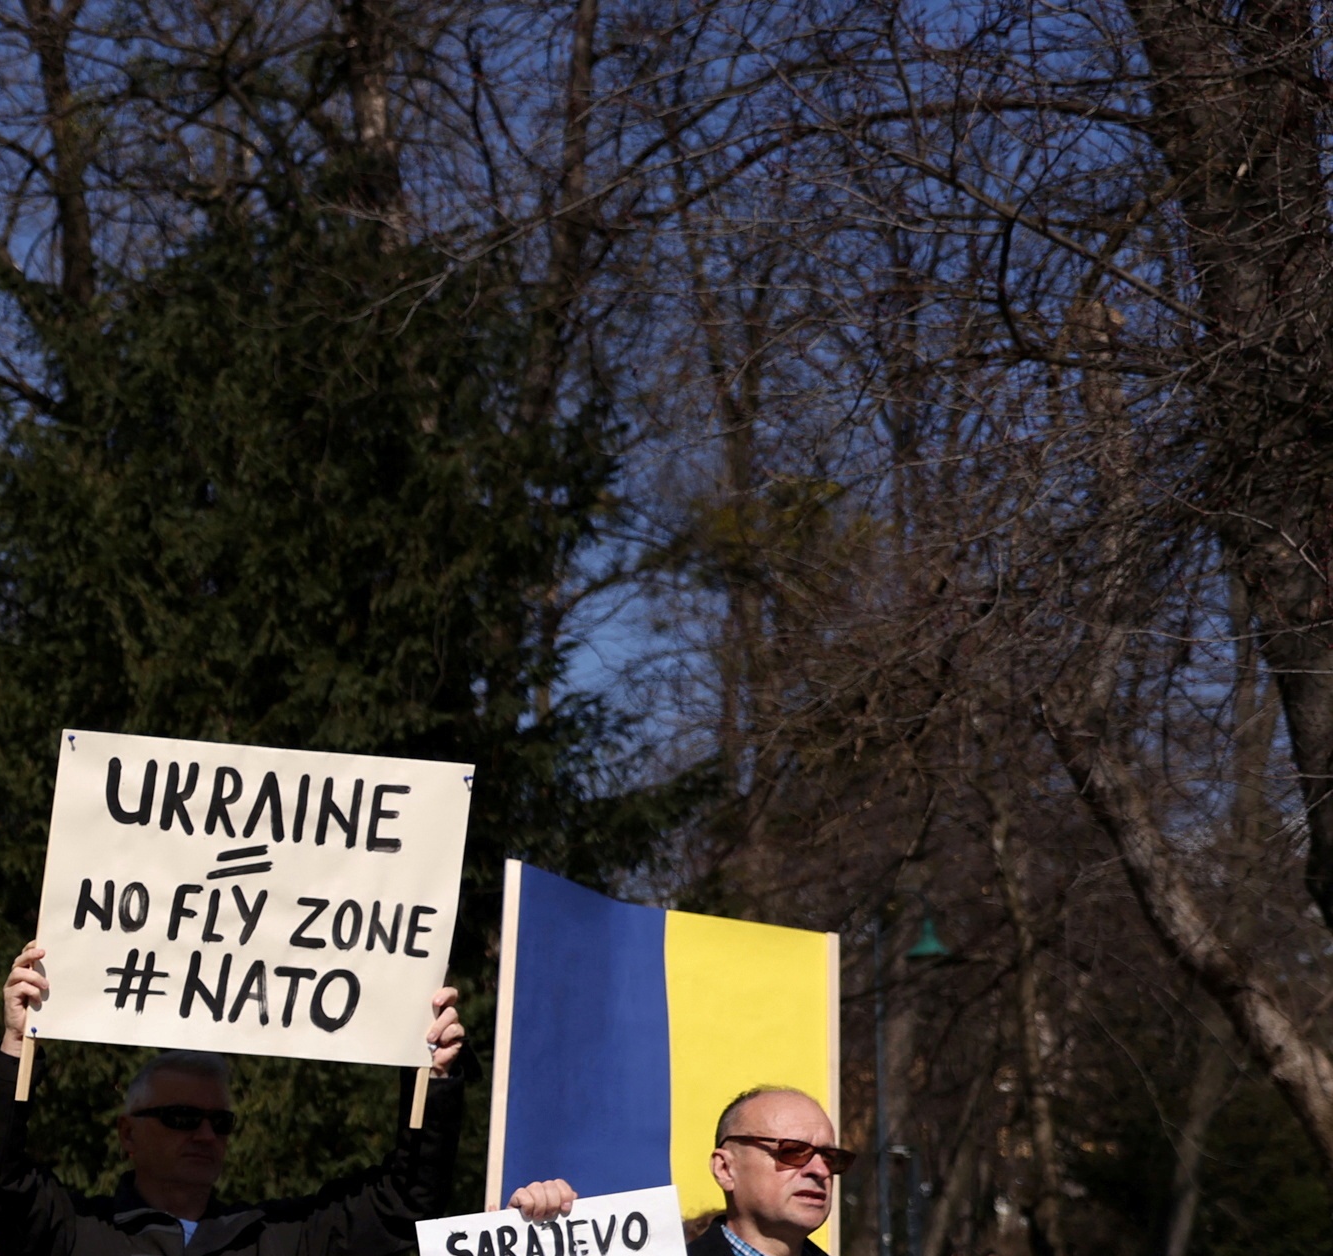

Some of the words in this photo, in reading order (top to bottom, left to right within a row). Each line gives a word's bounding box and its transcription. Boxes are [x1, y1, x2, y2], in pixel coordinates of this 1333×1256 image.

[105, 757, 411, 853] UKRAINE
[73, 878, 149, 932] NO
[167, 884, 268, 945] FLY
[289, 897, 437, 958] ZONE
[104, 948, 361, 1033] #NATO
